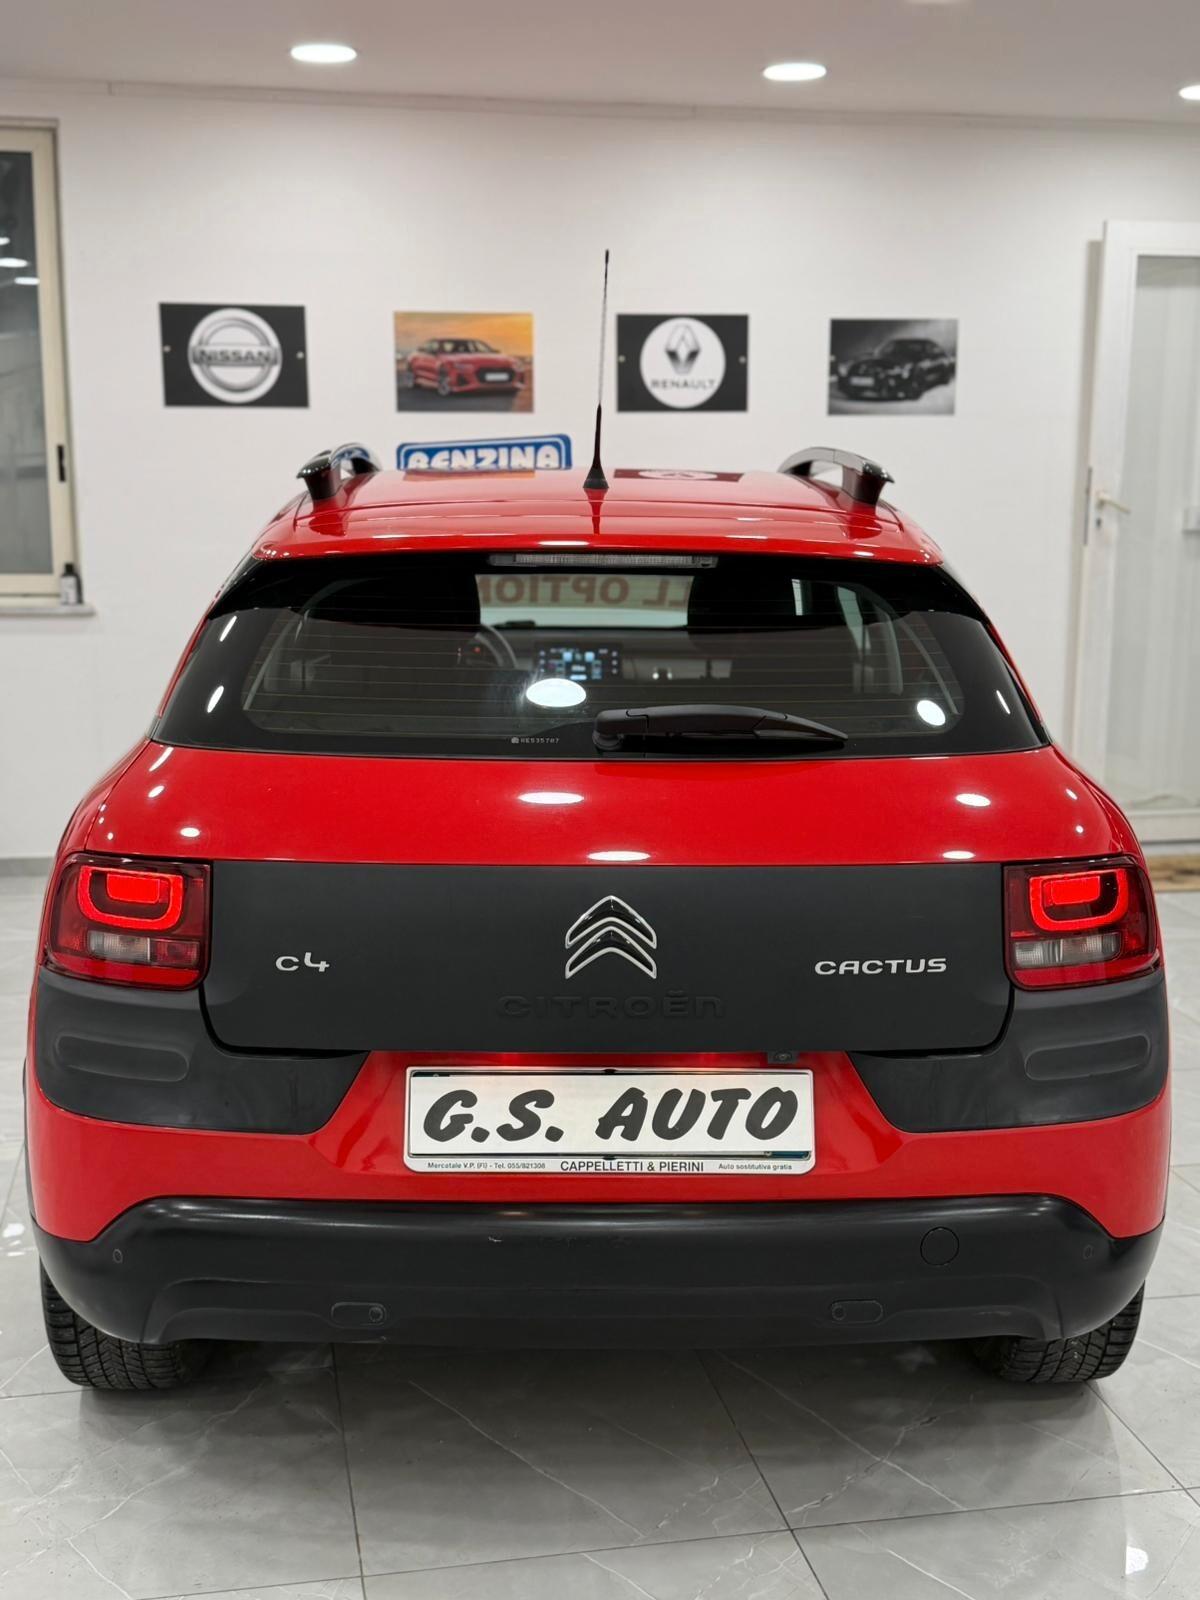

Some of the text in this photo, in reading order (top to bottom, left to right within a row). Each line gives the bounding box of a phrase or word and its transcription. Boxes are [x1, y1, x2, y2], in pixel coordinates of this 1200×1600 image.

[199, 349, 272, 361] NISSAN
[651, 379, 717, 390] RENAULT
[275, 952, 330, 972] C4
[814, 958, 947, 975] CACTUS
[423, 1086, 799, 1143] G.S. AUTO
[494, 1161, 506, 1169] Tel.
[560, 1160, 643, 1172] CAPPELLETTI
[647, 1161, 655, 1172] &
[659, 1161, 704, 1172] PIERINI
